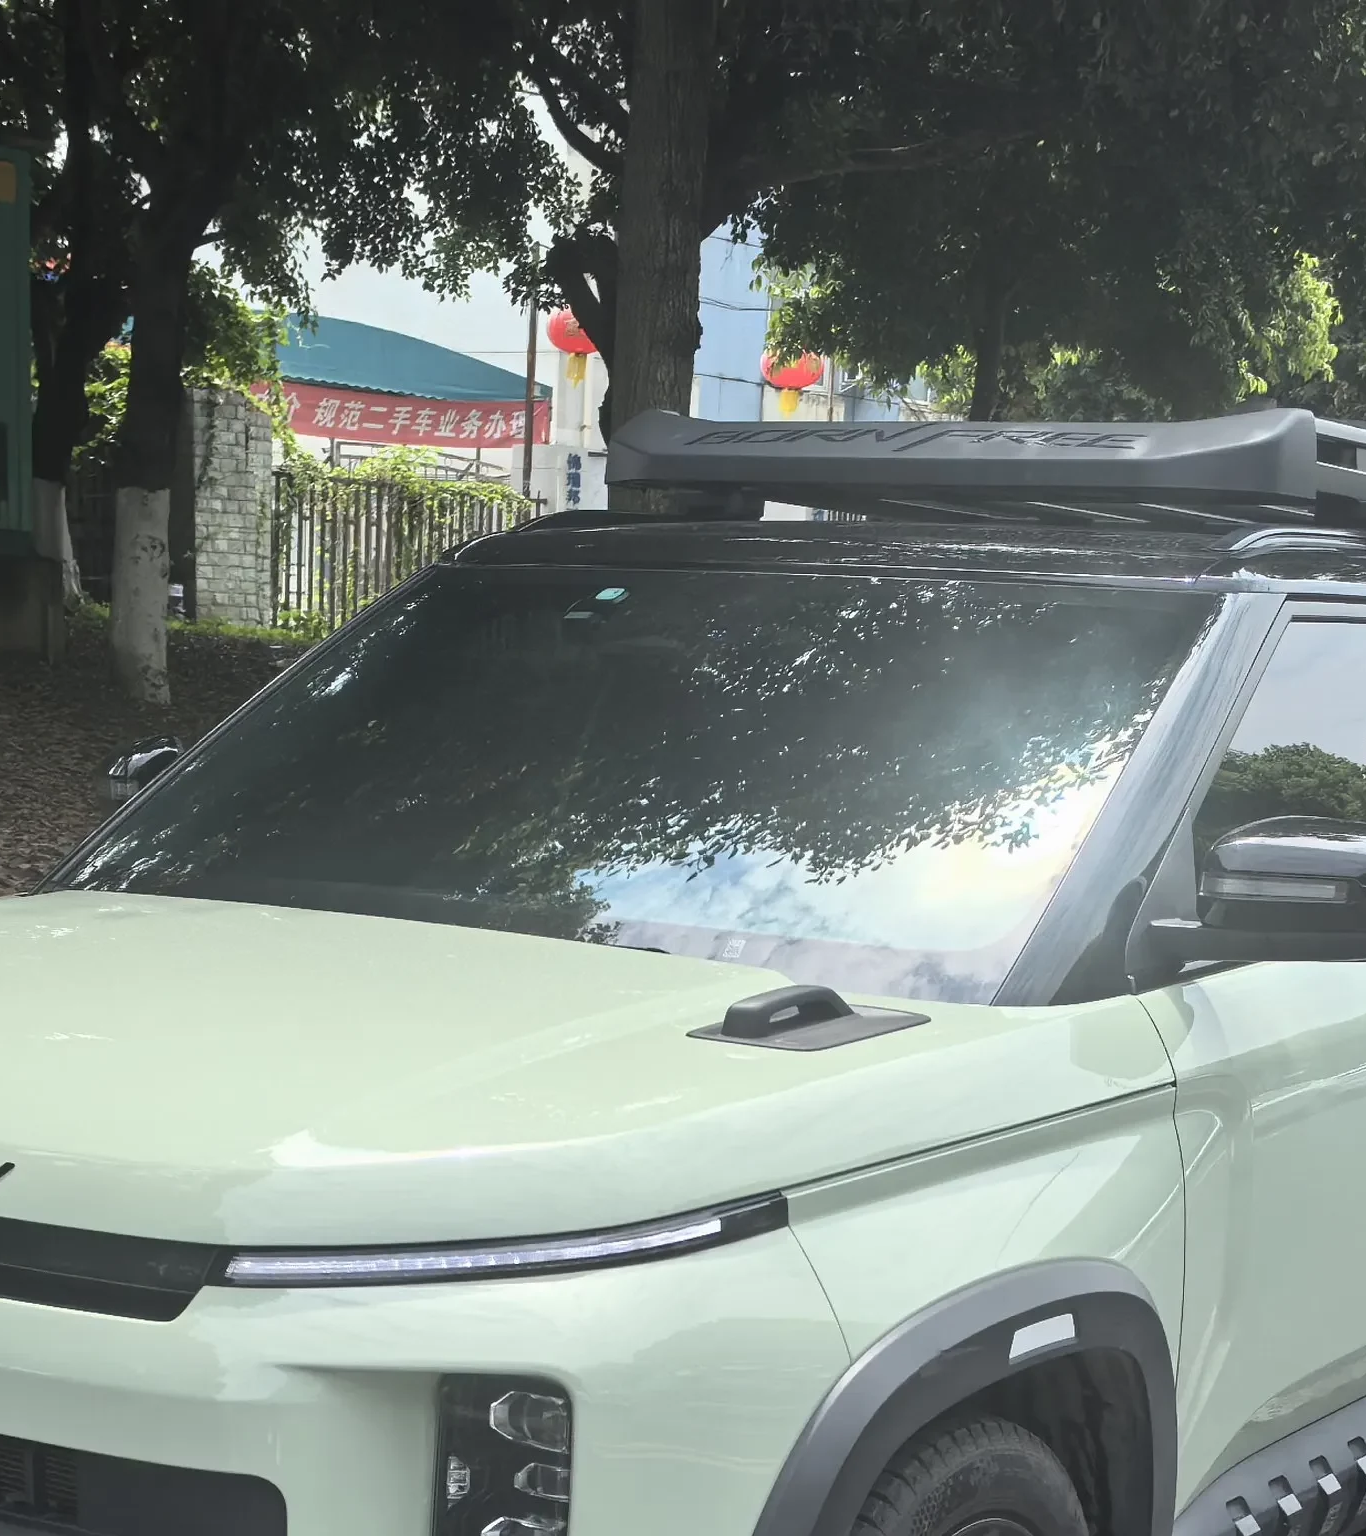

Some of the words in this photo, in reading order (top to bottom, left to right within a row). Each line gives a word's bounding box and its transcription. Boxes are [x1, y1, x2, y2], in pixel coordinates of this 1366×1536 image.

[312, 397, 526, 439] 规范二手车业务办理
